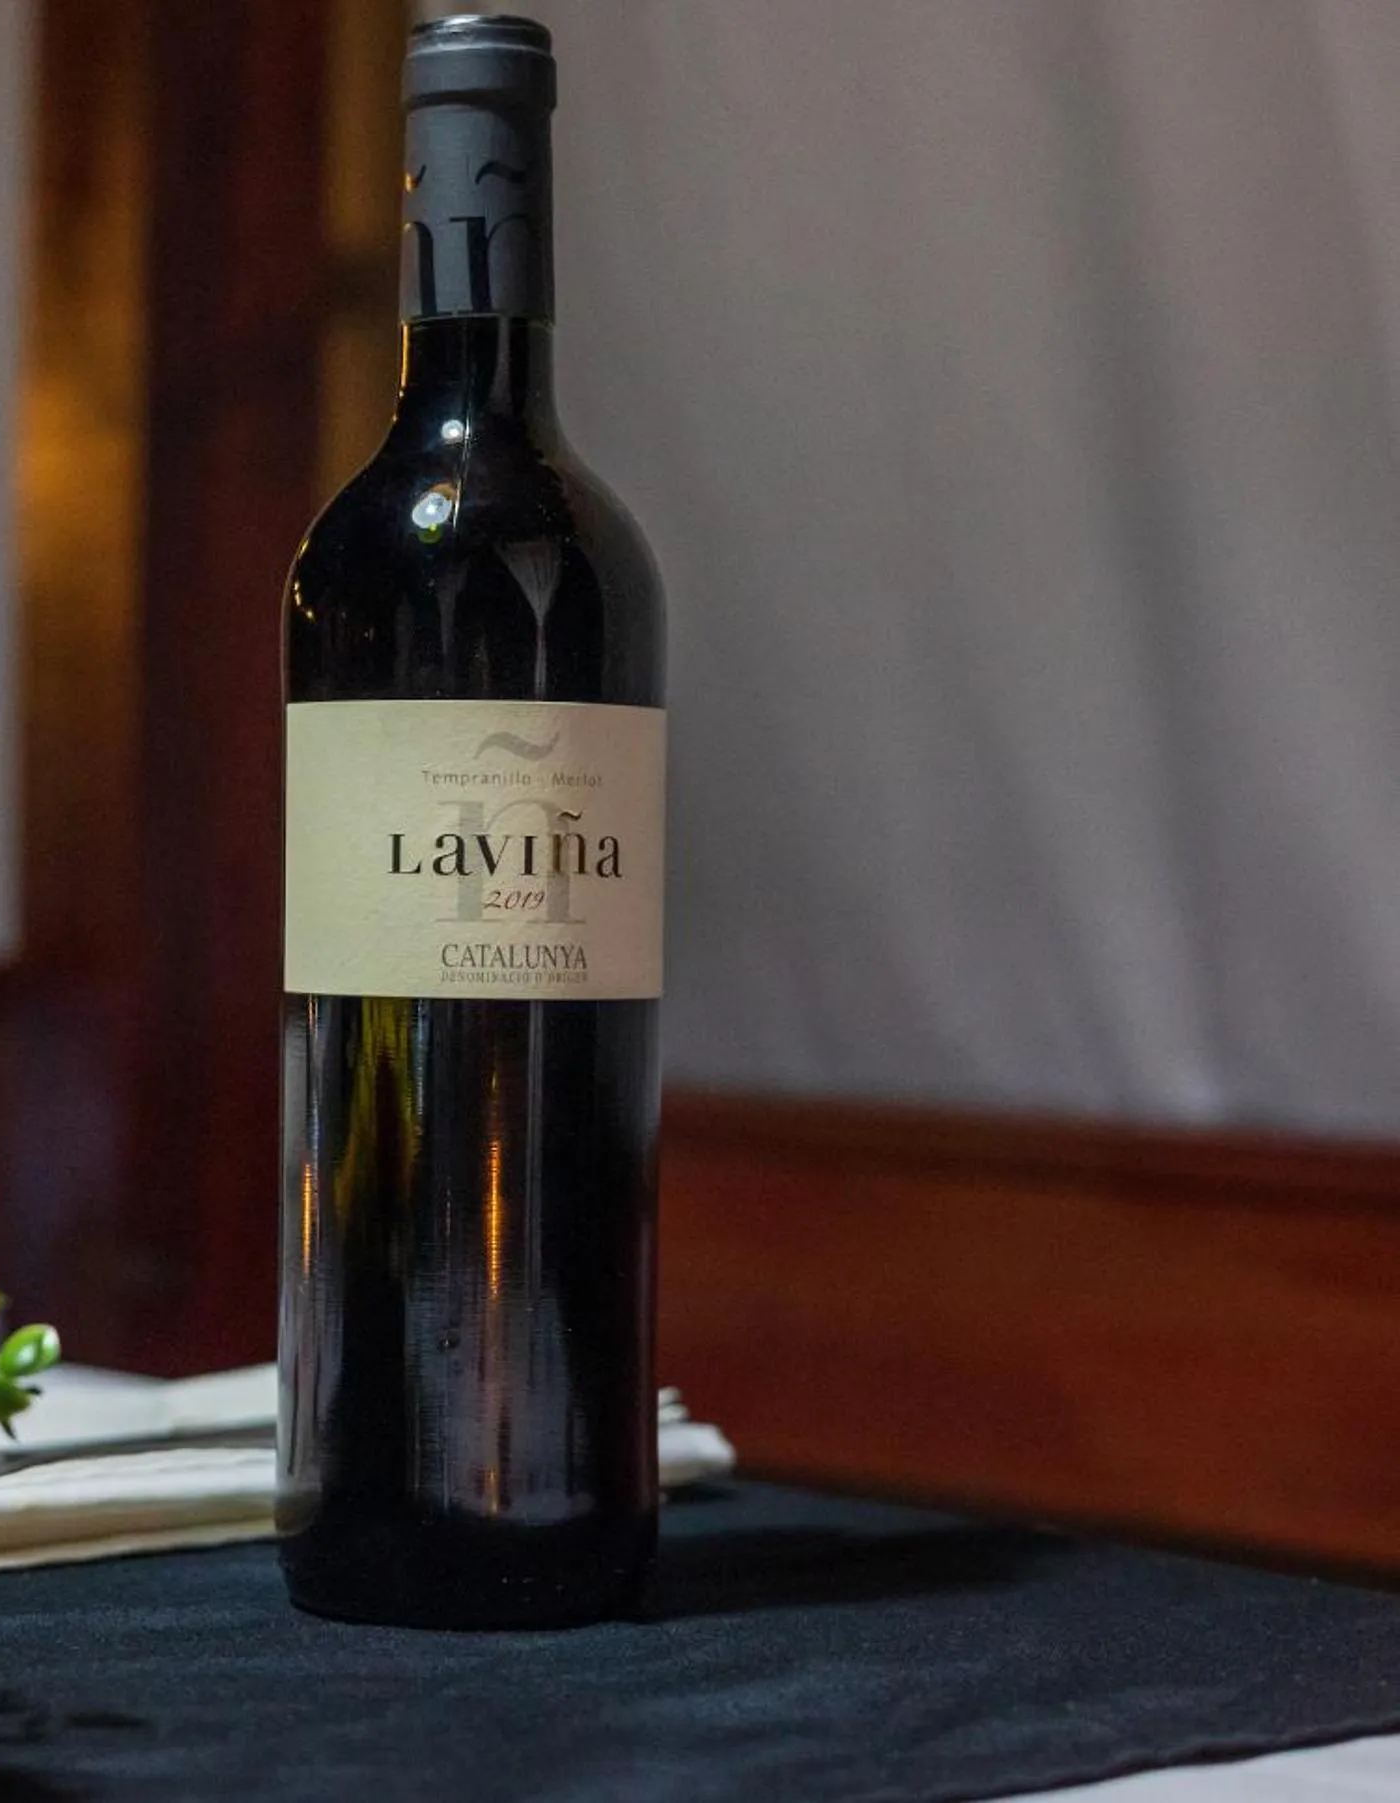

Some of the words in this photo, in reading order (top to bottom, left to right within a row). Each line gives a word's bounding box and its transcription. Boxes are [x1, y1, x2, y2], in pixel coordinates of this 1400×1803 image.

[421, 770, 532, 787] Tempranillo
[552, 770, 603, 787] Merlot
[482, 889, 547, 910] 2019
[441, 943, 588, 969] CATALUNYA
